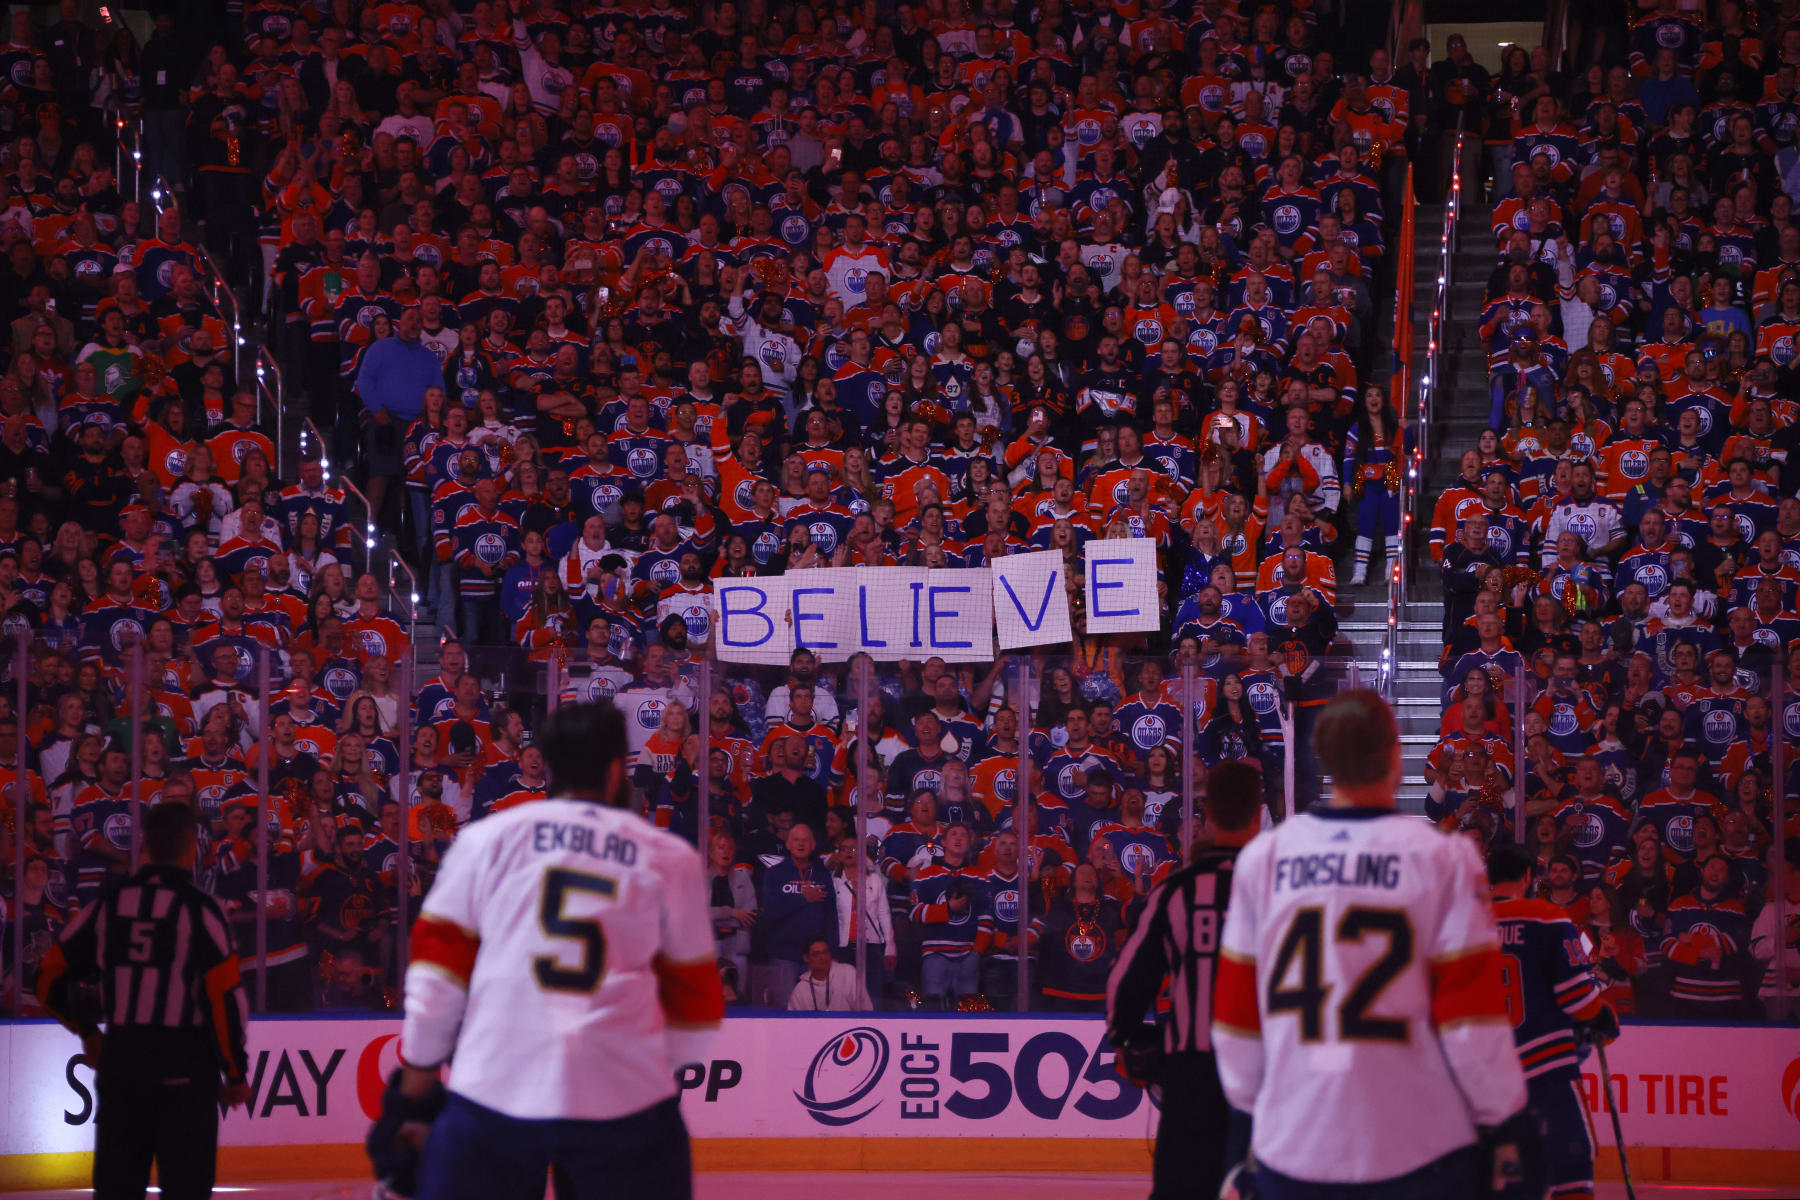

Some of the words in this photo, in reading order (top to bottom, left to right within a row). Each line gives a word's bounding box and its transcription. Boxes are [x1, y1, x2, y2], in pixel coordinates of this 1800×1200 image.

[1623, 460, 1647, 471] OILERS
[1569, 523, 1594, 534] OILERS
[720, 558, 1140, 649] BELIEVE
[1136, 727, 1161, 739] OILERS
[533, 820, 638, 867] EKBLAD
[1275, 853, 1401, 894] FORSLING
[128, 920, 156, 964] 5
[531, 866, 619, 996] 5
[1267, 905, 1414, 1045] 42
[900, 1033, 940, 1119] EOCF
[1639, 1074, 1729, 1116] TIRE
